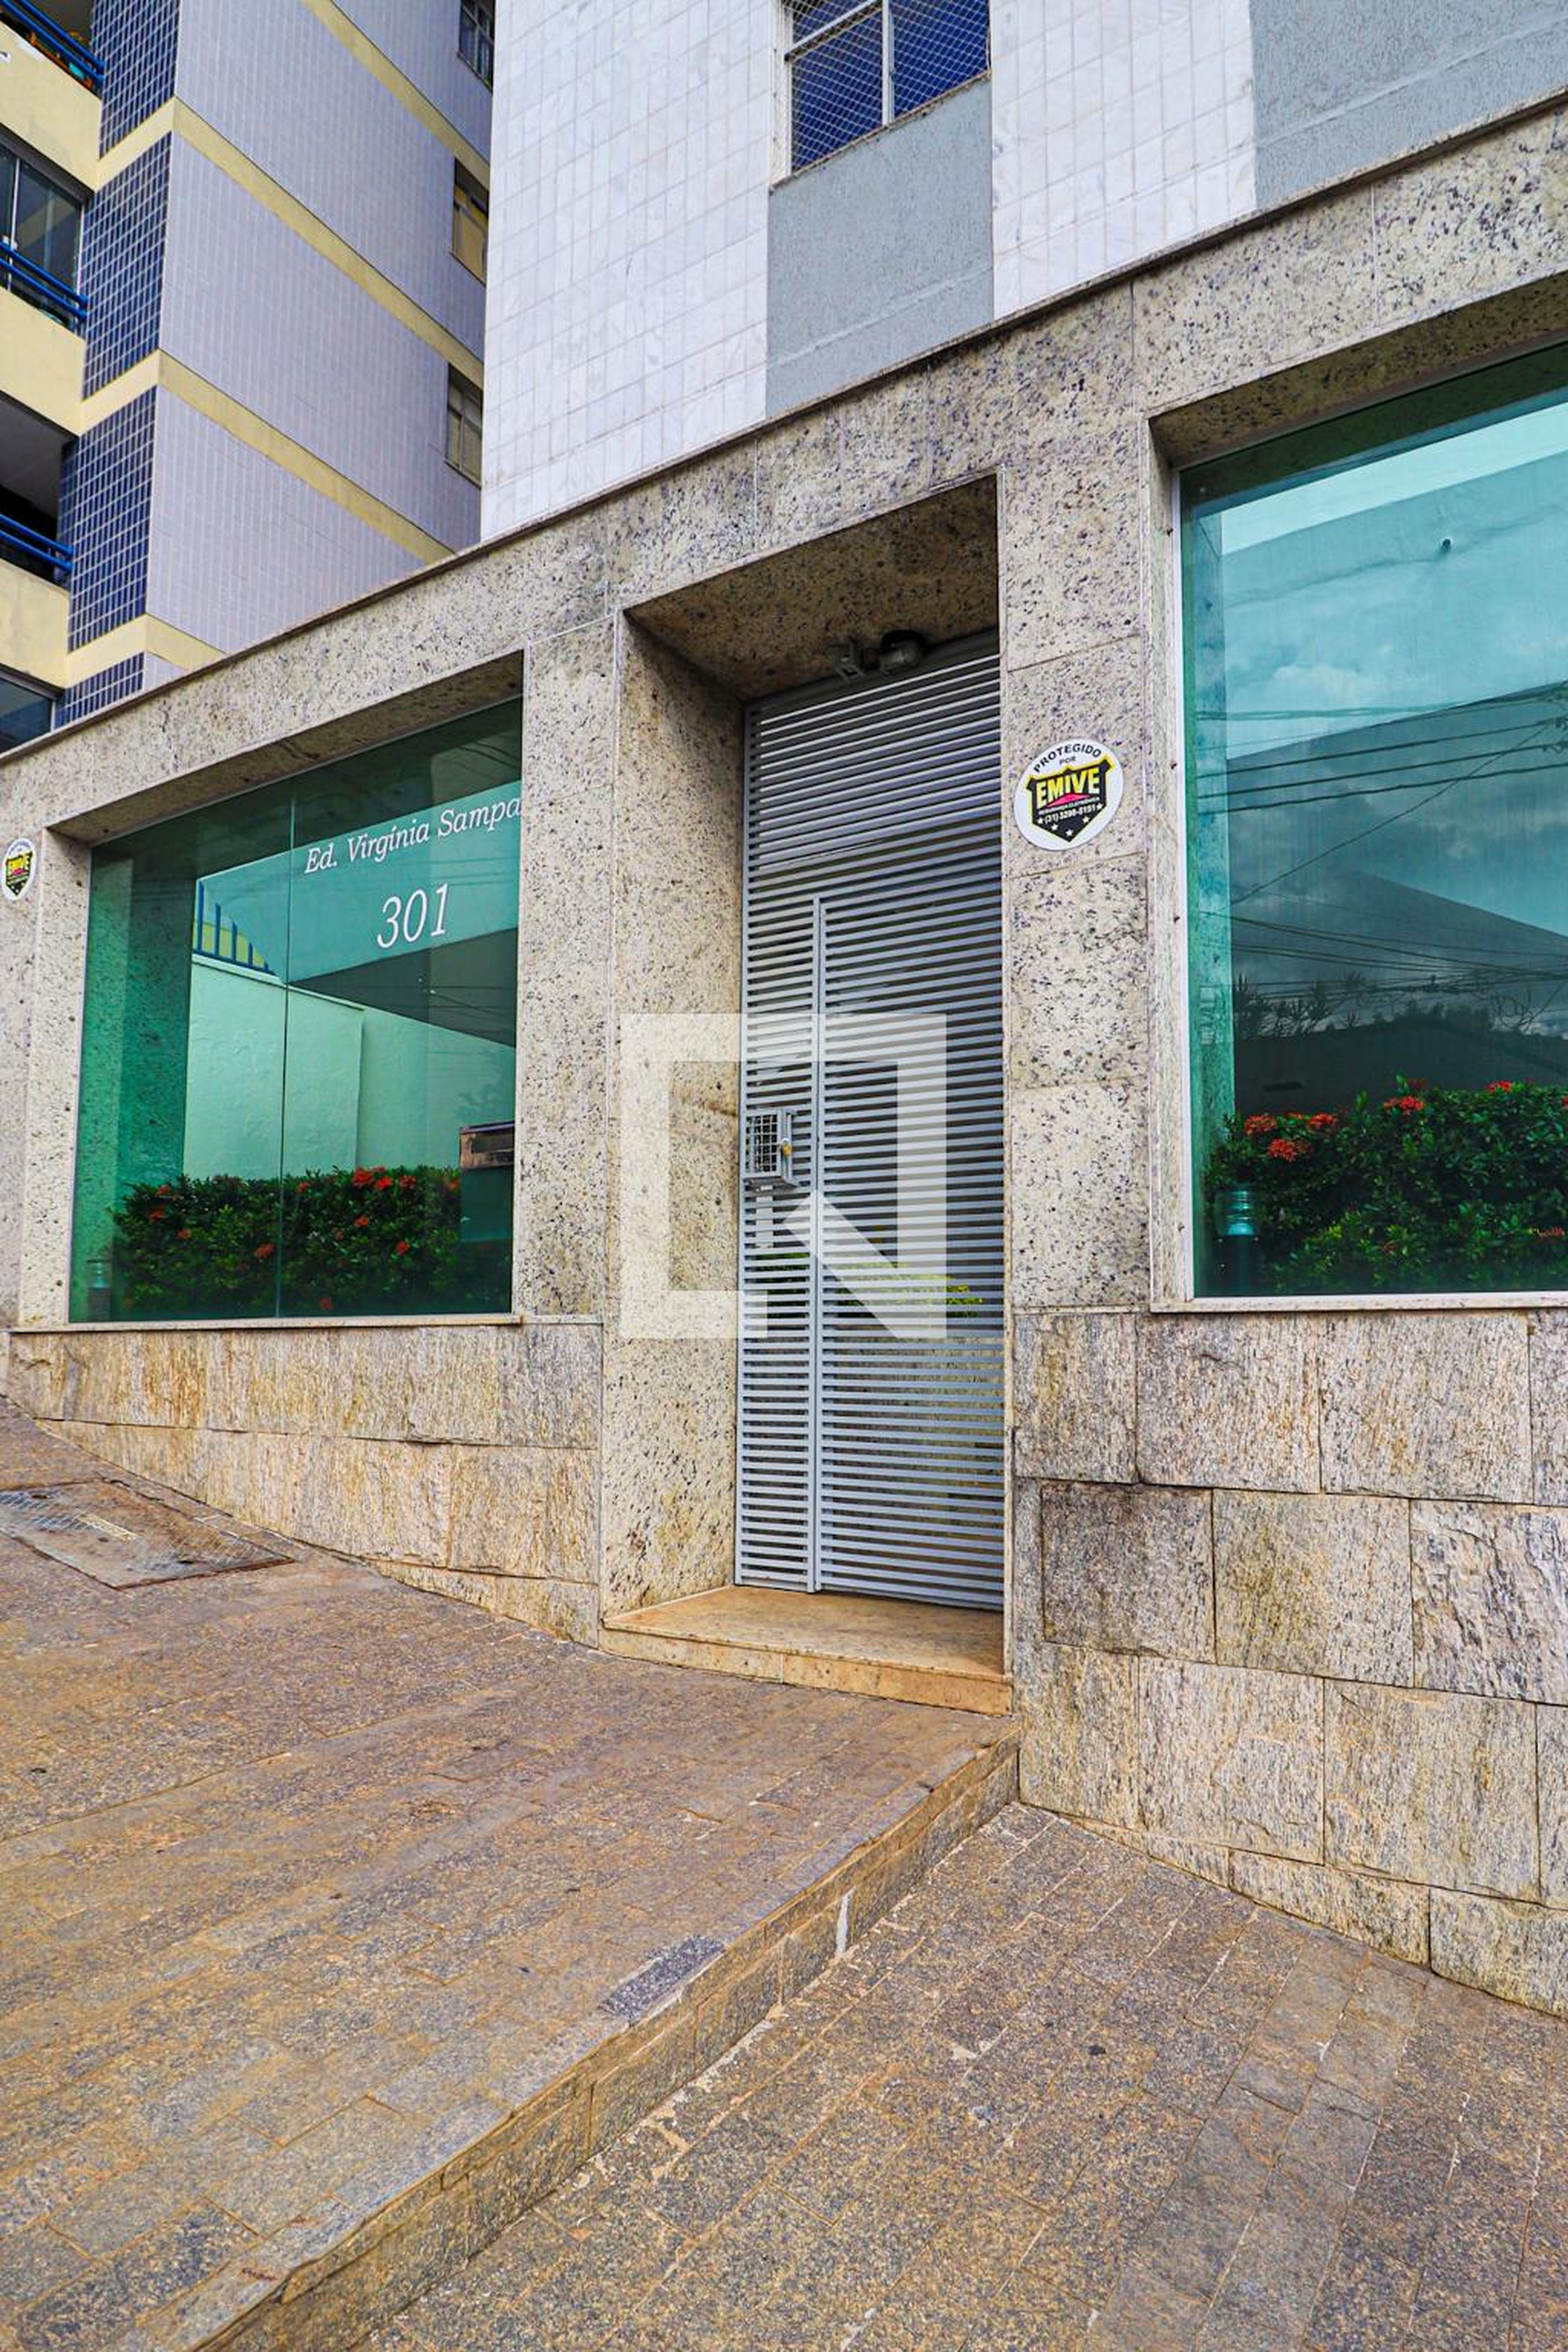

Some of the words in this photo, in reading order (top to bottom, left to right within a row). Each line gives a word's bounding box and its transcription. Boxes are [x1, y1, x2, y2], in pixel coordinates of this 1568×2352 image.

[1033, 743, 1102, 773] PROTEGIDO
[1036, 767, 1100, 810] EMIVE
[304, 842, 337, 874] Ed.
[347, 819, 430, 862] Virgínia
[376, 882, 449, 949] 301
